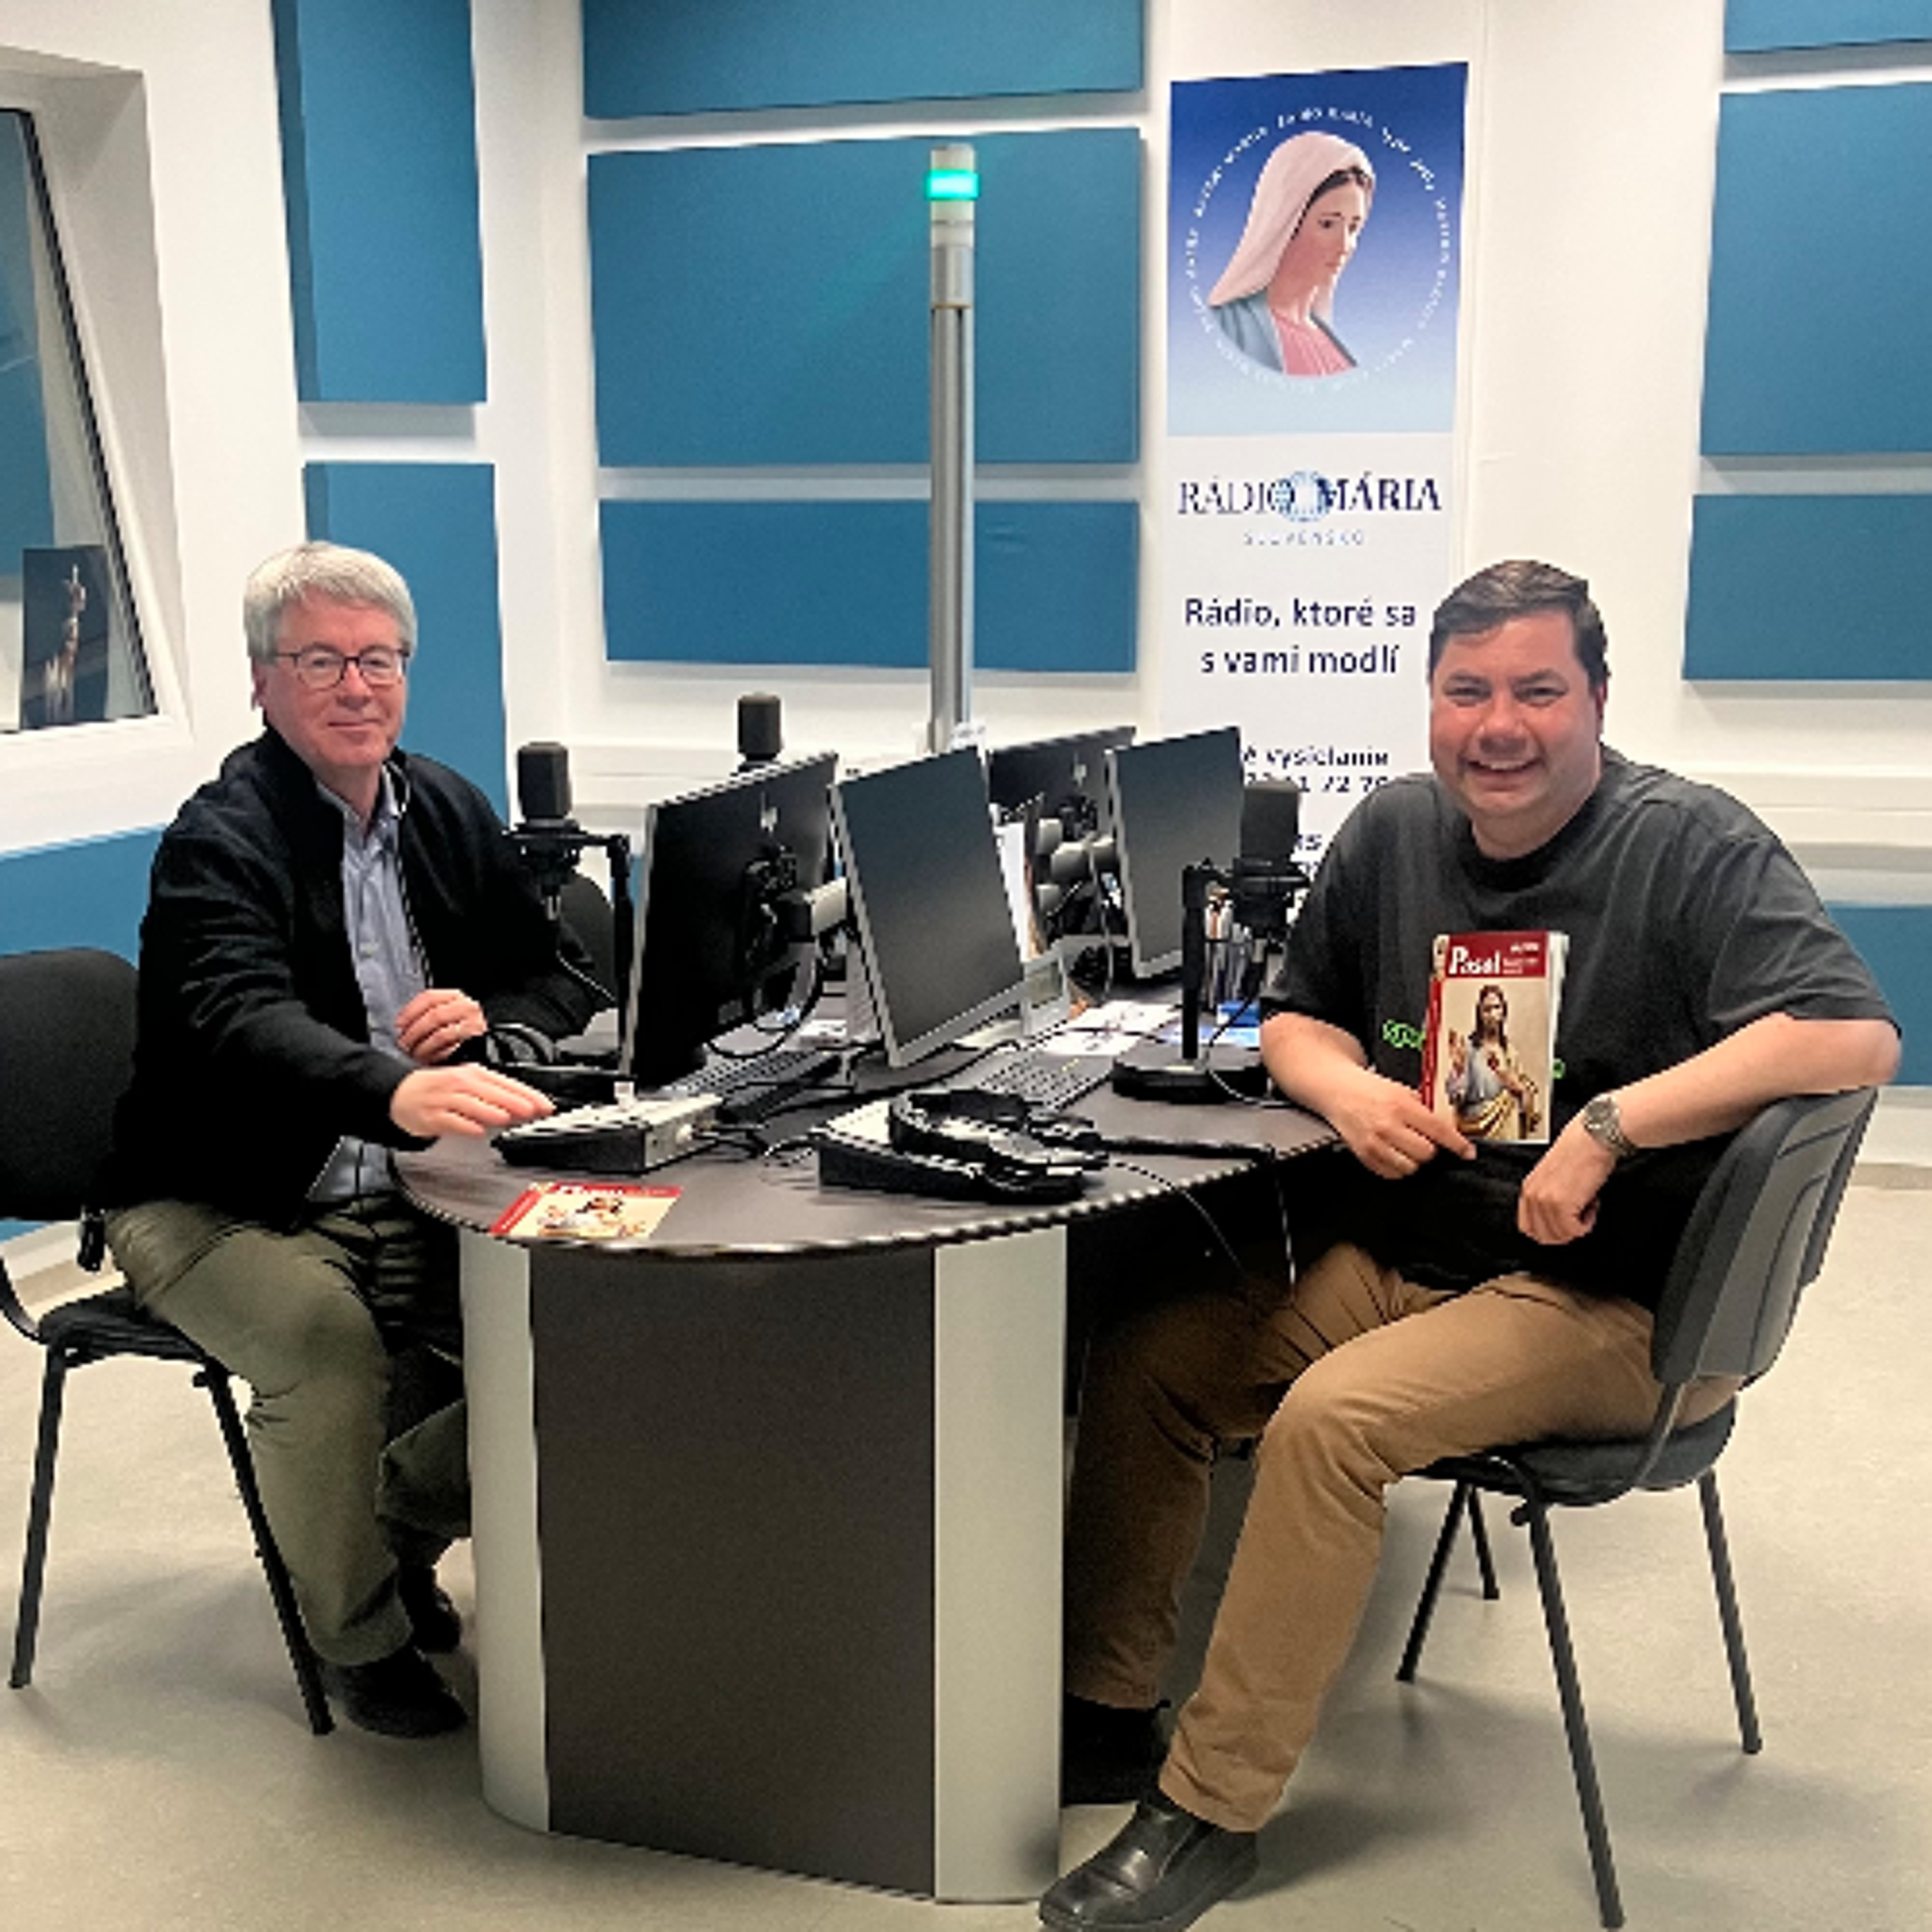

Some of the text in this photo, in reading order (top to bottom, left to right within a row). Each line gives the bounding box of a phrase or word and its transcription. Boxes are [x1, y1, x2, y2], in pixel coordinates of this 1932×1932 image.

[1178, 471, 1442, 513] RÁDIO MÁRIA
[1186, 595, 1415, 629] Rádio, ktoré sa
[1201, 644, 1399, 674] s vami modlí
